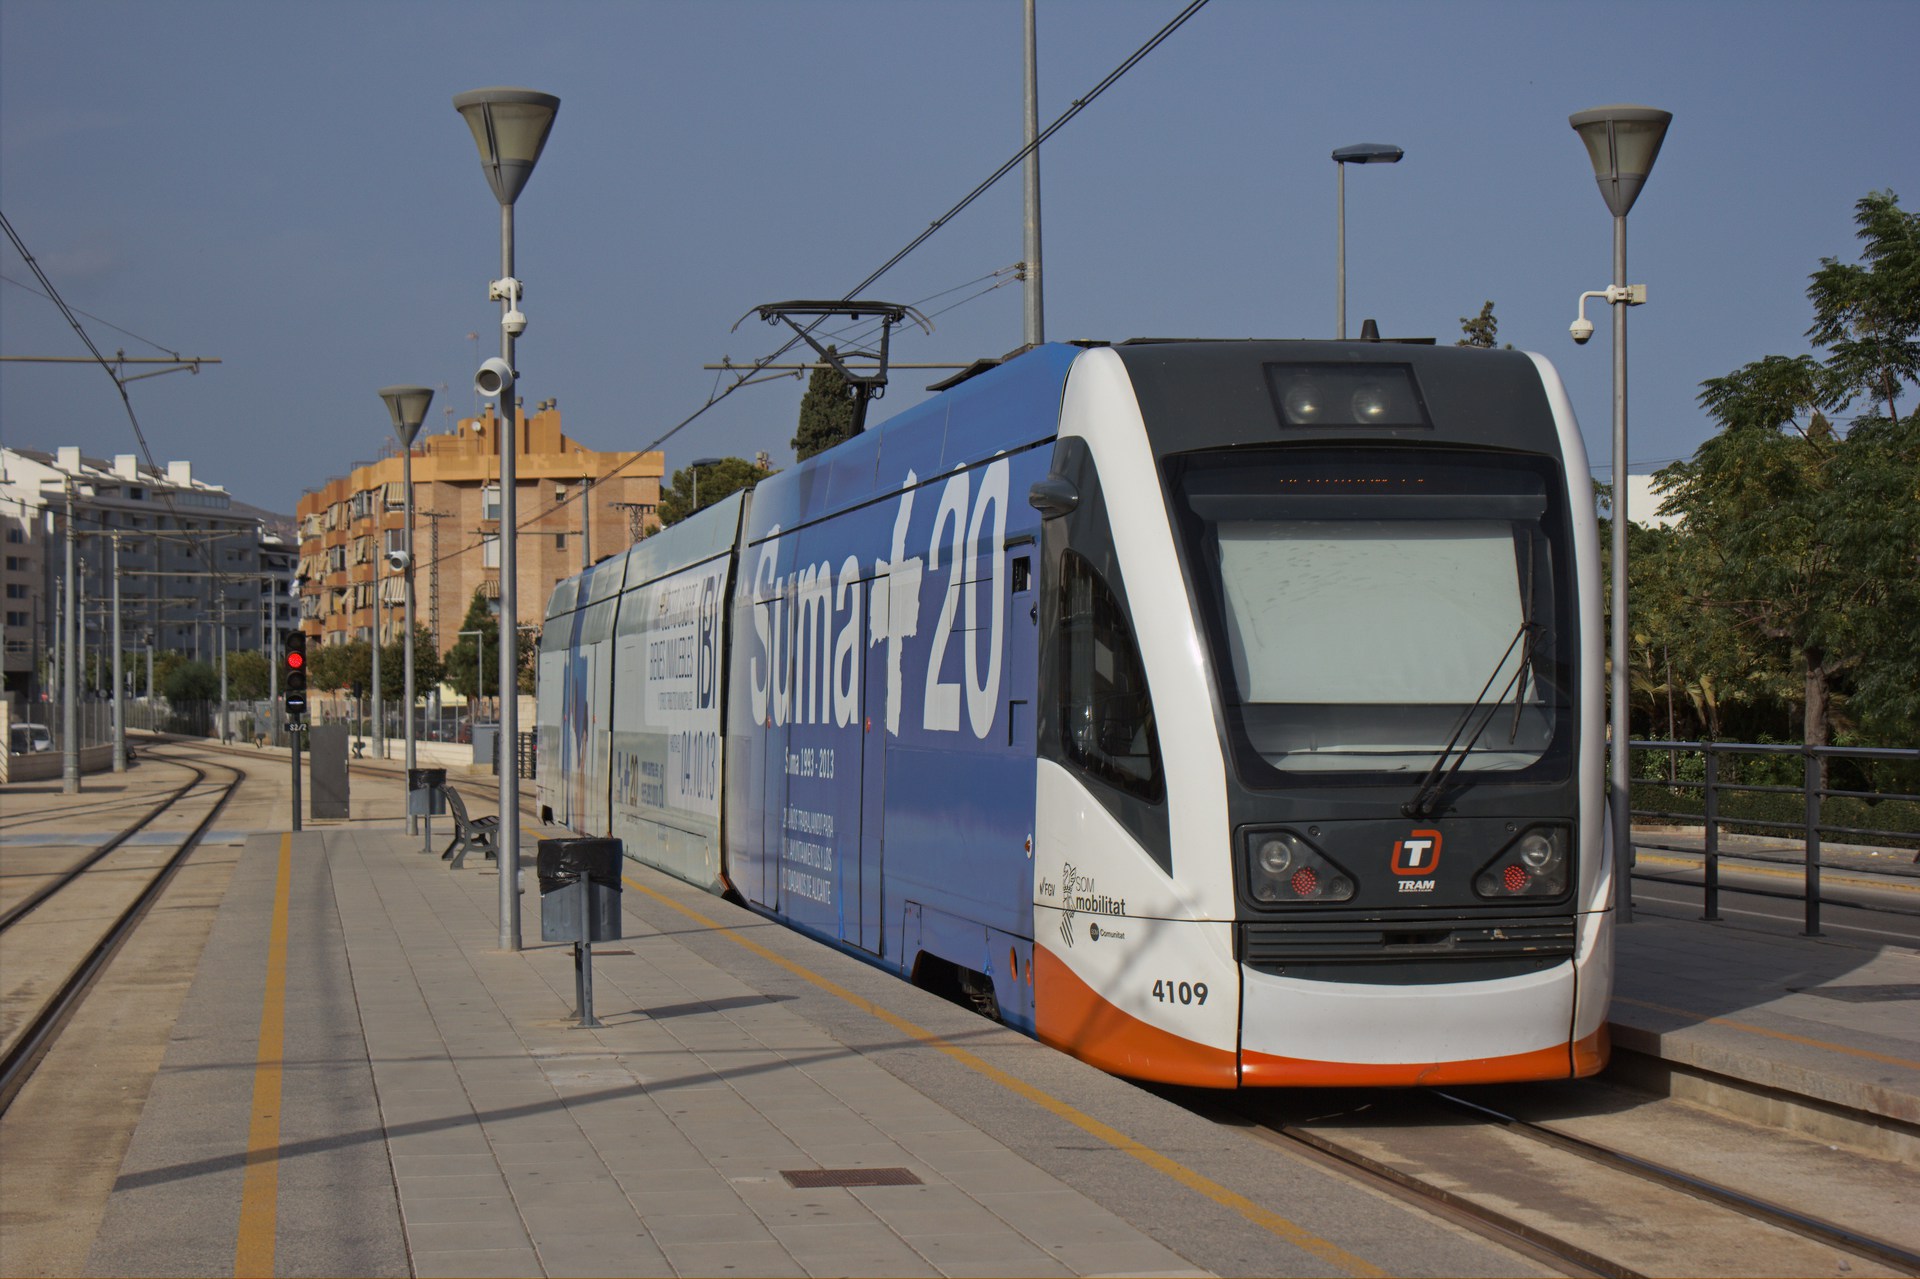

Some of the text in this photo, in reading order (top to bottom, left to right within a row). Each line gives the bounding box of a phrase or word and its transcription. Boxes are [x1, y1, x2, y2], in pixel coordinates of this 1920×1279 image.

[751, 524, 860, 728] Suma
[697, 573, 722, 709] IBI
[800, 747, 815, 777] 1993
[819, 747, 835, 780] 2013
[783, 868, 806, 896] CUDADANOS
[1045, 882, 1056, 897] FGV
[1076, 876, 1095, 893] SOM
[1398, 880, 1436, 889] TRAM
[1076, 894, 1126, 915] mobilitat
[1100, 929, 1126, 940] Comunitat
[1152, 979, 1209, 1006] 4109
